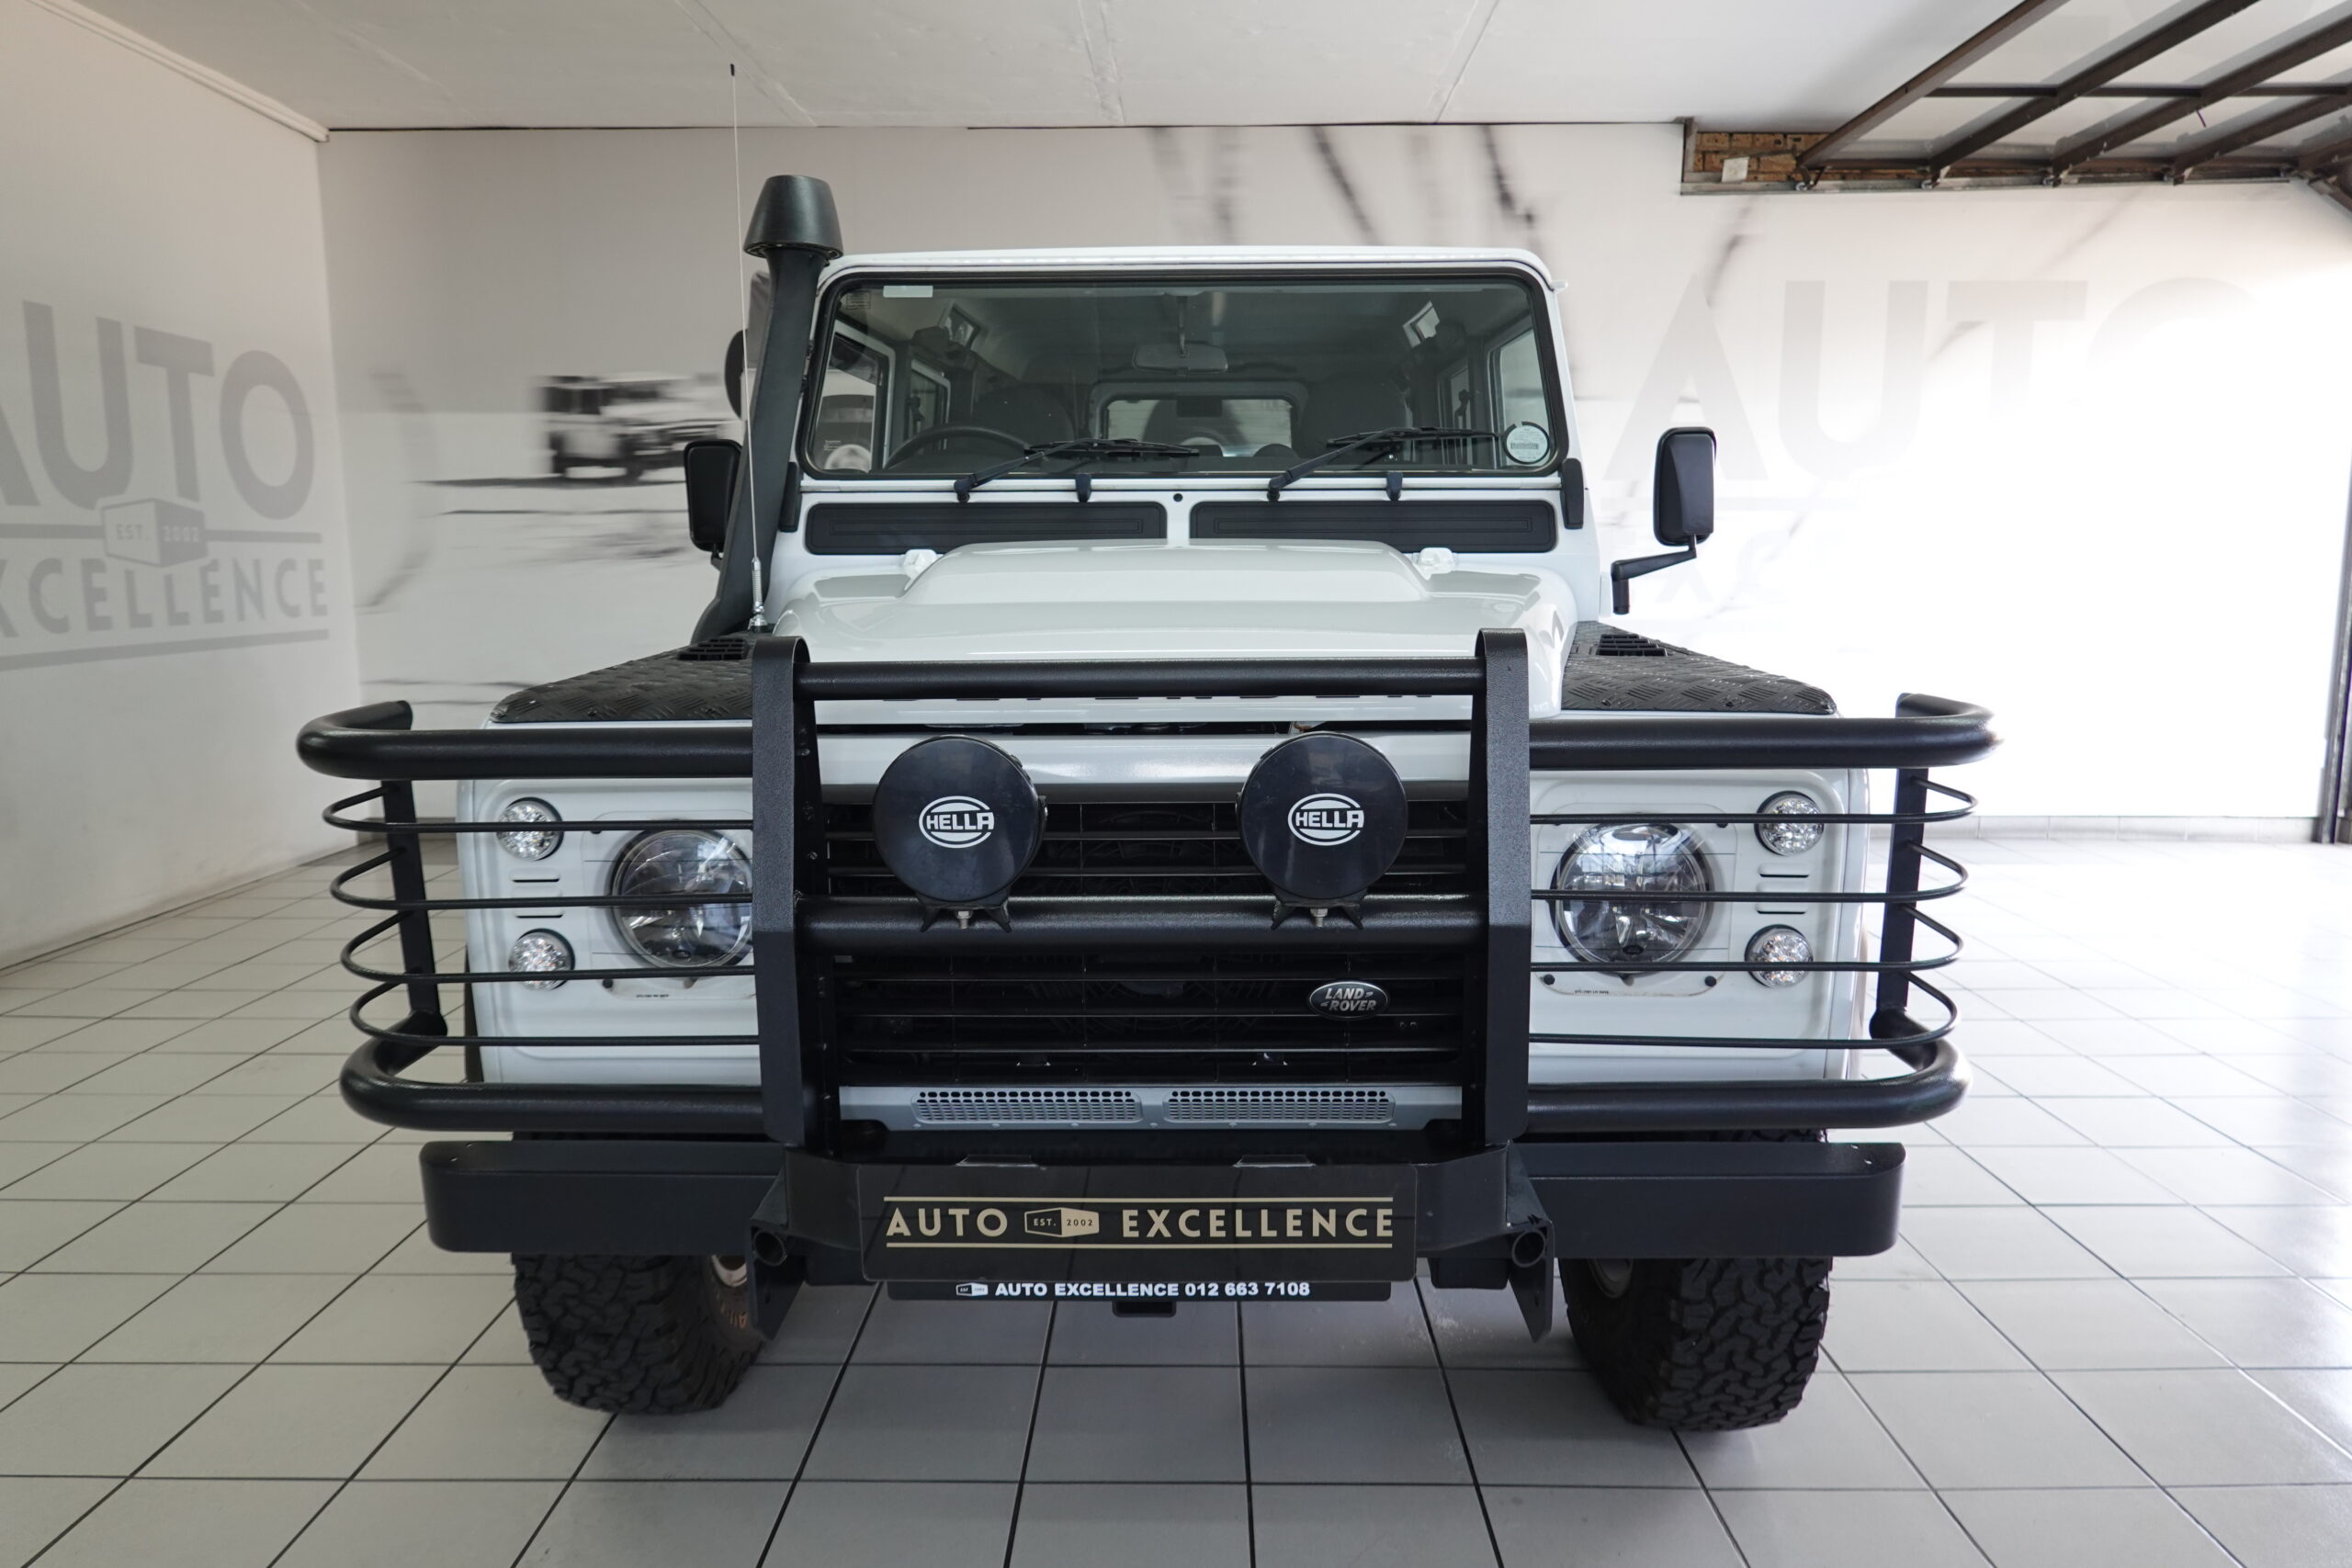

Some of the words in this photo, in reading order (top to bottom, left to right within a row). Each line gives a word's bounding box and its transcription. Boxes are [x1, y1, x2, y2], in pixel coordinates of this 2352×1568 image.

[926, 812, 995, 830] HELLA
[1295, 810, 1364, 828] HELLA
[1325, 987, 1365, 999] LAND
[1329, 999, 1376, 1011] ROVER
[886, 1207, 1008, 1236] AUTO
[1034, 1218, 1057, 1226] EST.
[1122, 1208, 1393, 1238] EXCELLENCE
[995, 1282, 1047, 1296] AUTO
[1055, 1283, 1179, 1296] EXCELLENCE
[1184, 1282, 1219, 1296] 012
[1225, 1282, 1259, 1296] 663
[1265, 1282, 1310, 1296] 7108
